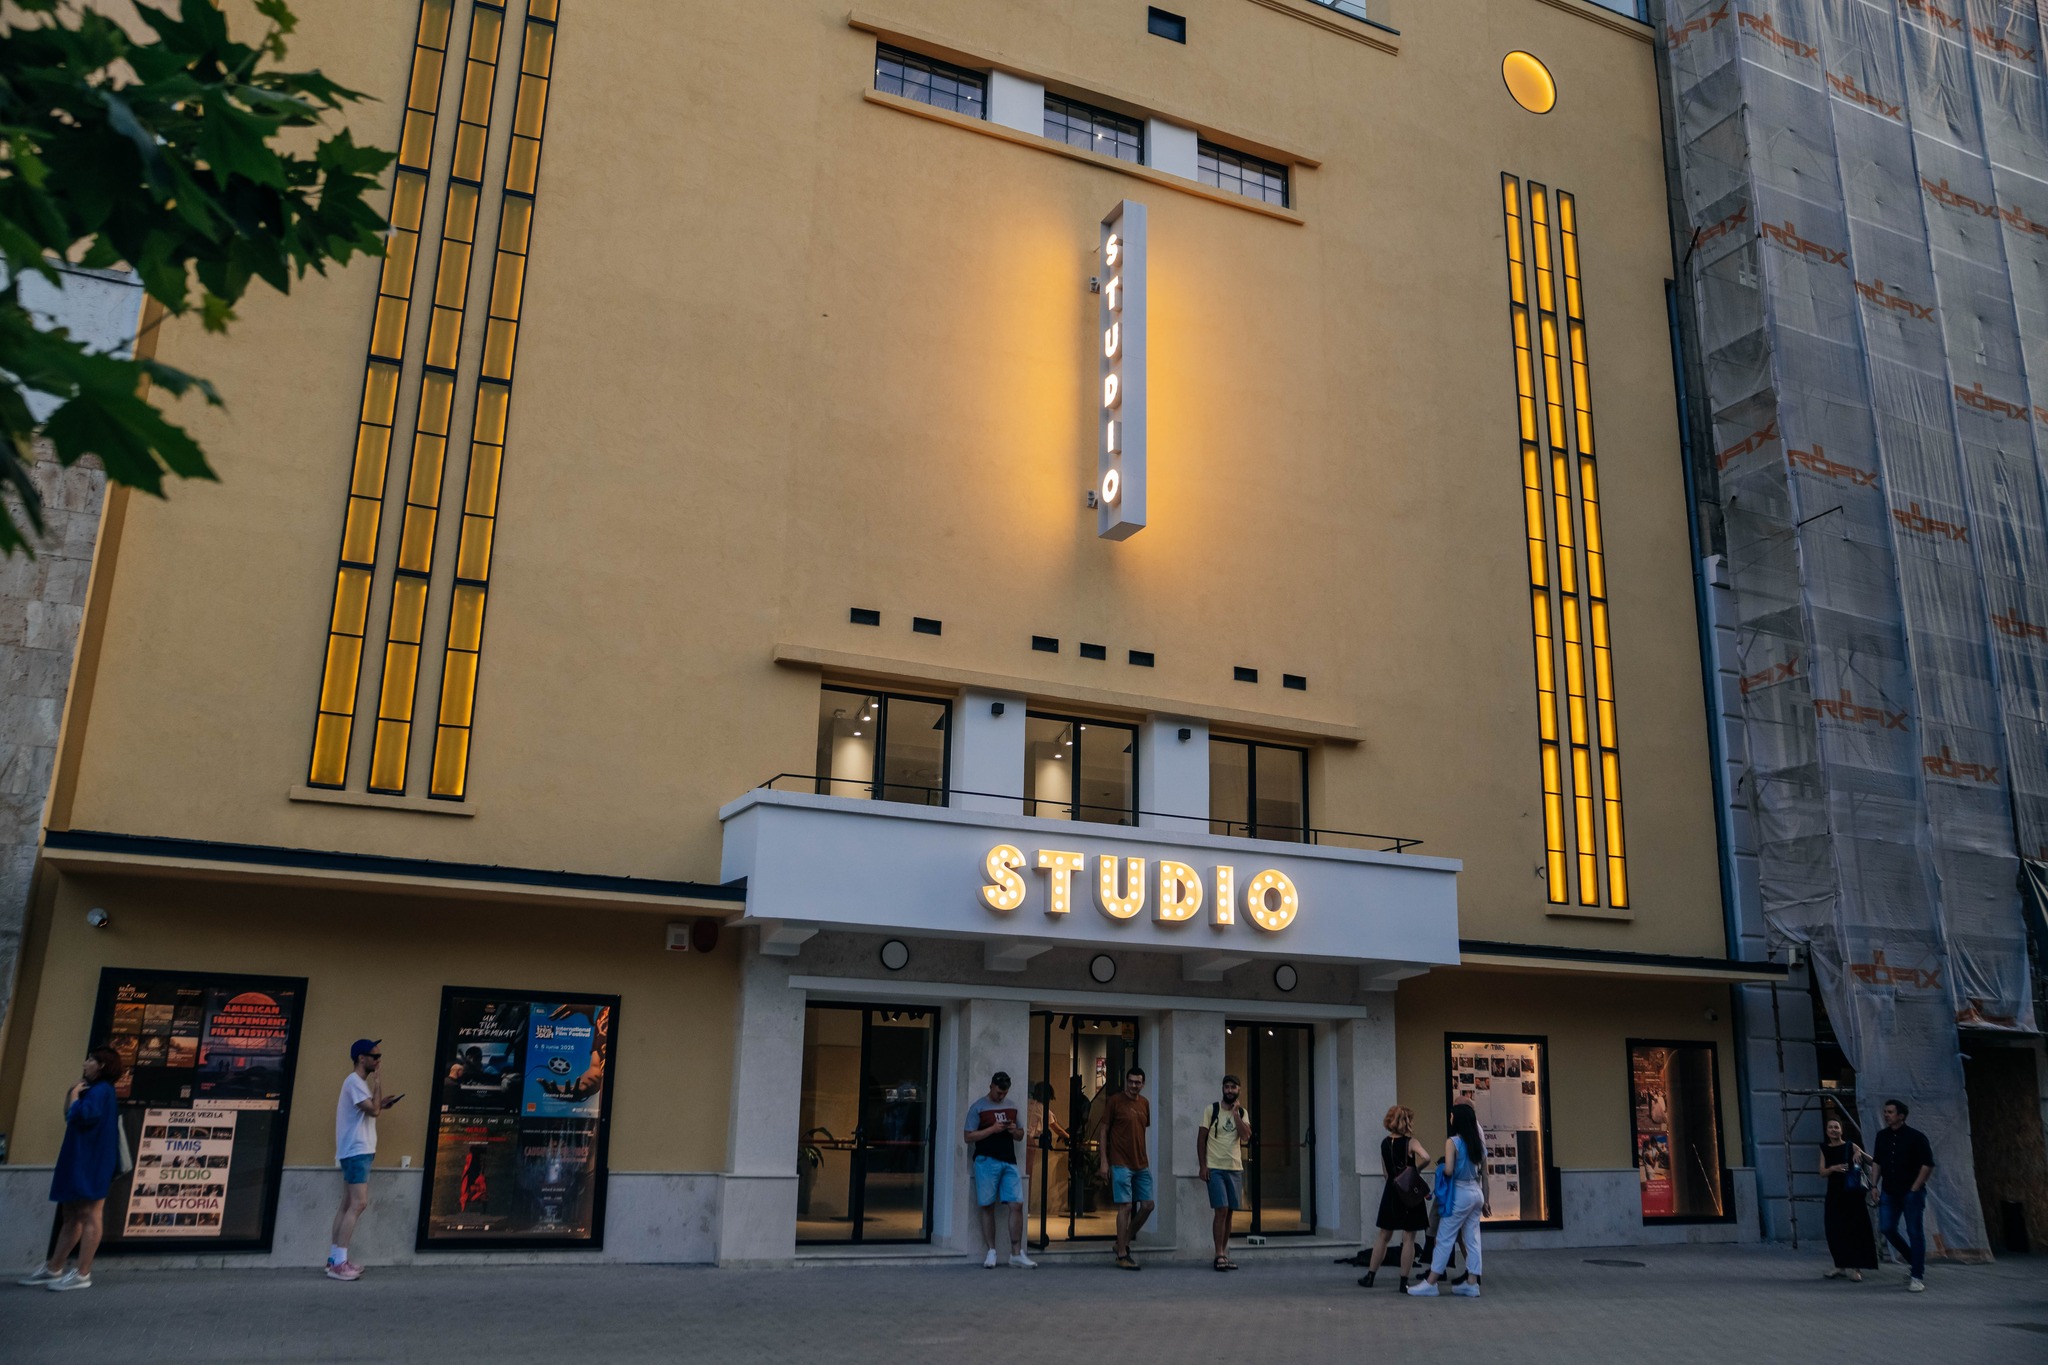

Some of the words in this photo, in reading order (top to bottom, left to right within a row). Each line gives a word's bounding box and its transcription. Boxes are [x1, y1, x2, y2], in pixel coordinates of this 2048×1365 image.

[1761, 220, 1849, 270] RÖFIX
[1101, 233, 1122, 504] STUDIO
[1787, 443, 1879, 491] RÖFIX
[1813, 688, 1910, 733] RÖFIX
[977, 844, 1299, 932] STUDIO
[223, 1004, 280, 1014] AMERICAN
[213, 1015, 288, 1027] INDEPENDENT
[210, 1027, 236, 1037] FILM
[238, 1028, 286, 1038] FESTIVAL
[165, 1140, 202, 1154] TIMIȘ
[159, 1169, 212, 1181] STUDIO
[155, 1198, 219, 1209] VICTORIA
